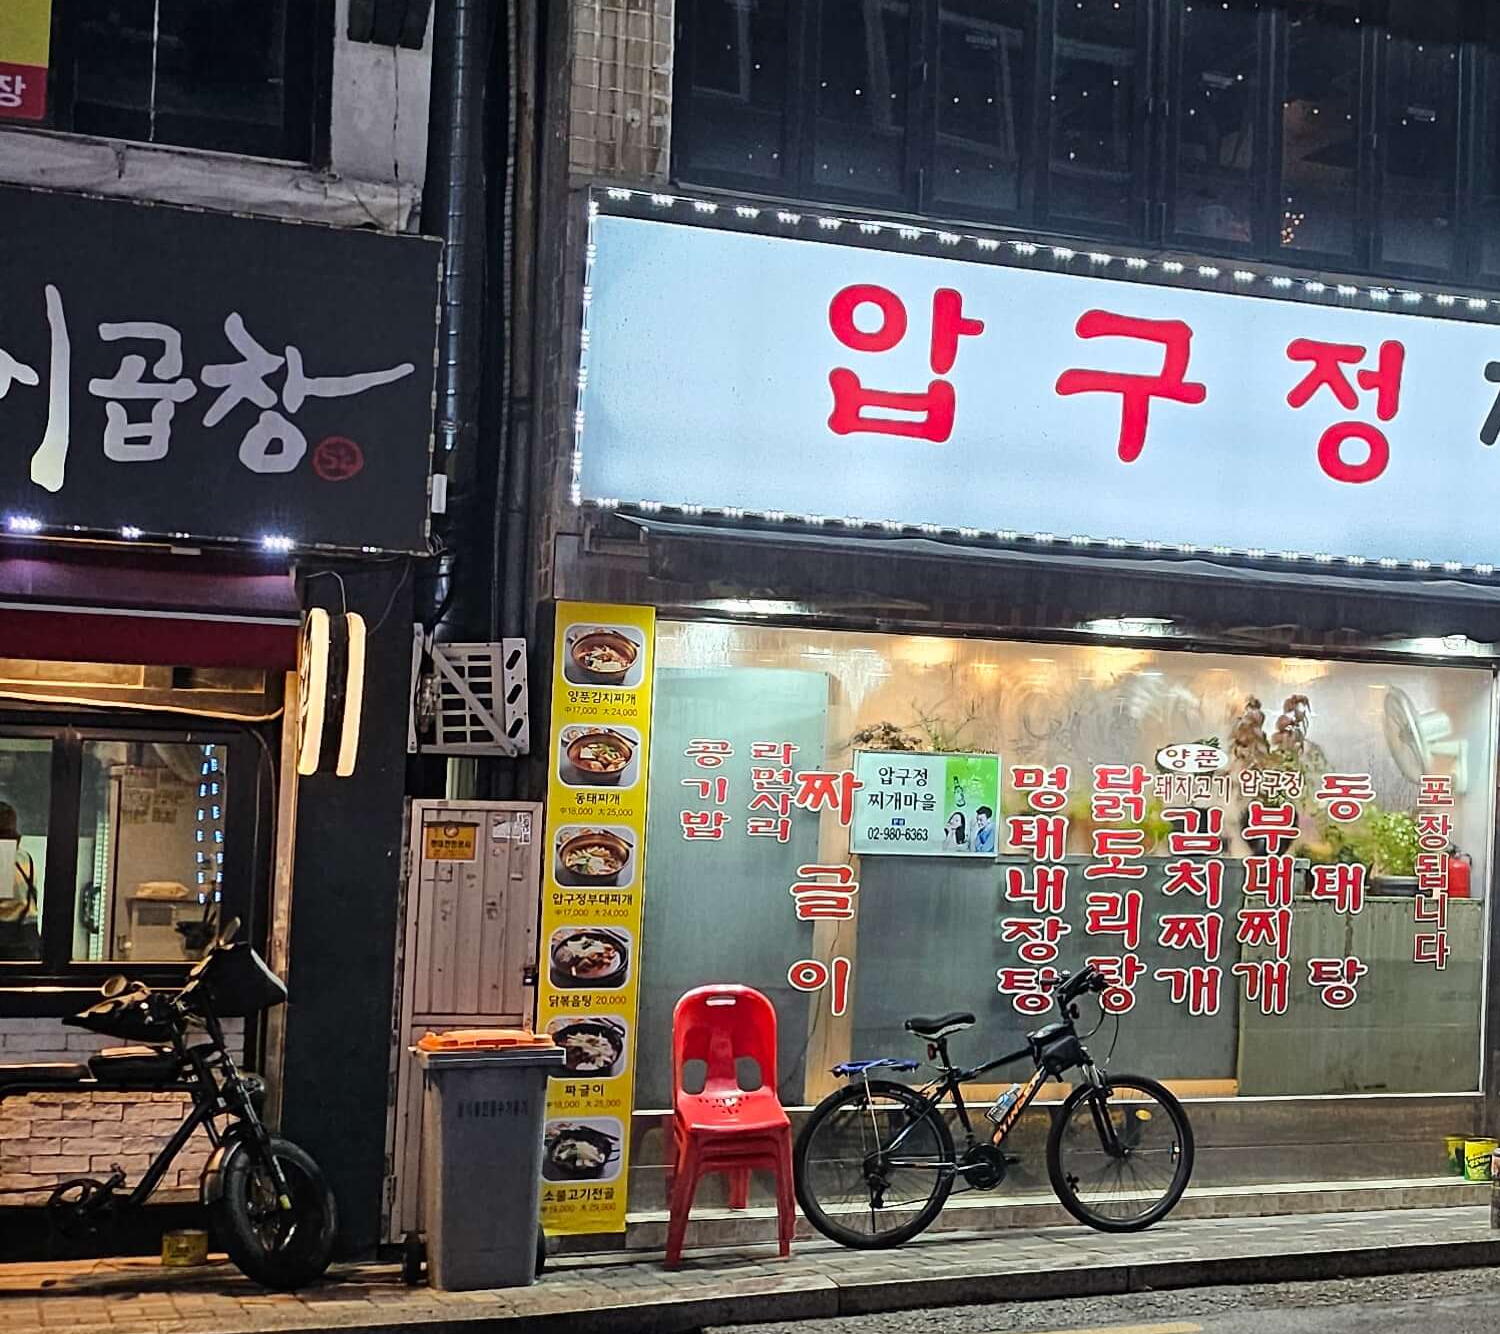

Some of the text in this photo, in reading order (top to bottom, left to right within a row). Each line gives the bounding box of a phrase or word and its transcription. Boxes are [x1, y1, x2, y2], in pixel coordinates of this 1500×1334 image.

[828, 283, 1406, 483] 압구정
[567, 690, 636, 705] 양푼김치찌개
[575, 793, 620, 805] 동태찌개
[681, 738, 732, 841] 공기밥
[748, 741, 800, 843] 라면사리
[867, 791, 937, 811] 찌개마을
[878, 767, 928, 787] 압구정
[1154, 775, 1231, 804] 돼지고기
[1166, 749, 1219, 768] 양푼
[1239, 769, 1304, 798] 압구정
[867, 827, 929, 841] 02-980-6363
[1414, 774, 1455, 971] 포장됩니다
[552, 893, 633, 907] 압구정부대찌개
[787, 770, 864, 1017] 짜글이
[997, 765, 1070, 1016] 명태내장탕
[1083, 765, 1151, 1015] 닭도리탕
[1153, 804, 1225, 1016] 김치찌개
[1233, 801, 1300, 1015] 부대찌개
[1306, 773, 1377, 1010] 동태탕
